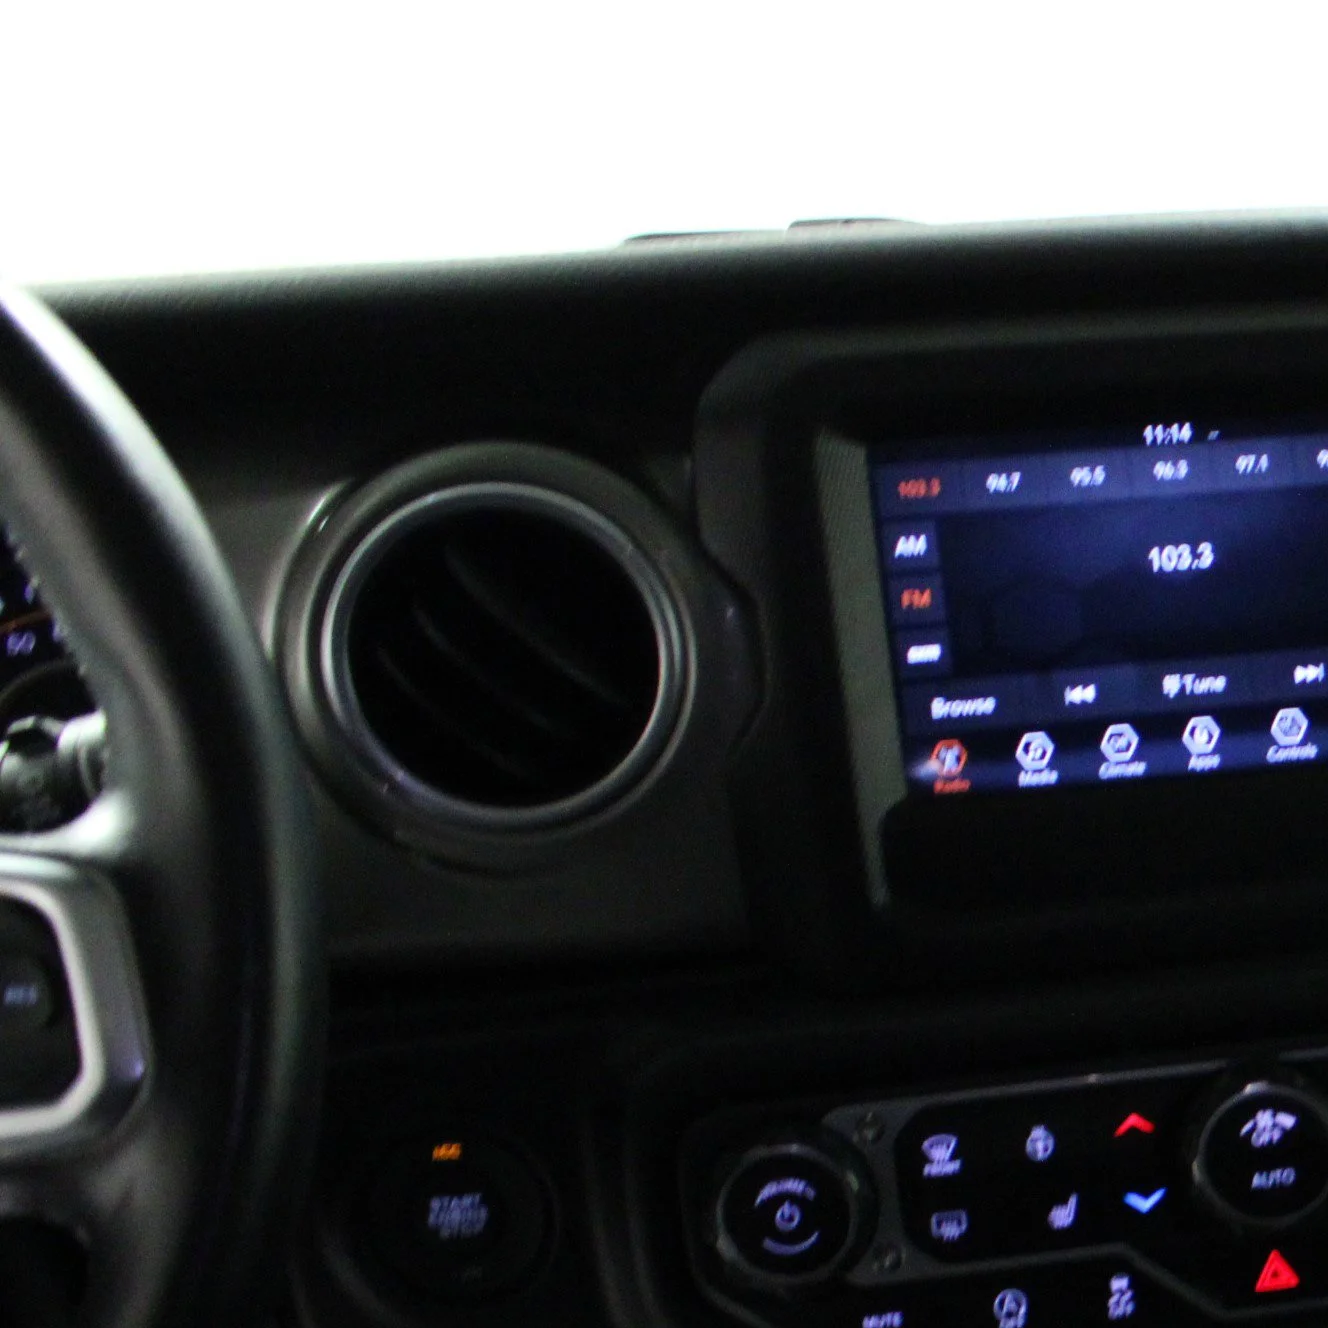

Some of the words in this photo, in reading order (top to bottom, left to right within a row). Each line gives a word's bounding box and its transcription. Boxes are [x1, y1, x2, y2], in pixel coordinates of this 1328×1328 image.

[894, 534, 928, 559] AM
[1149, 541, 1214, 573] 103.3
[901, 588, 932, 609] FM
[1182, 673, 1227, 695] Tune
[931, 696, 997, 720] Browse
[1251, 1167, 1296, 1190] AUTO
